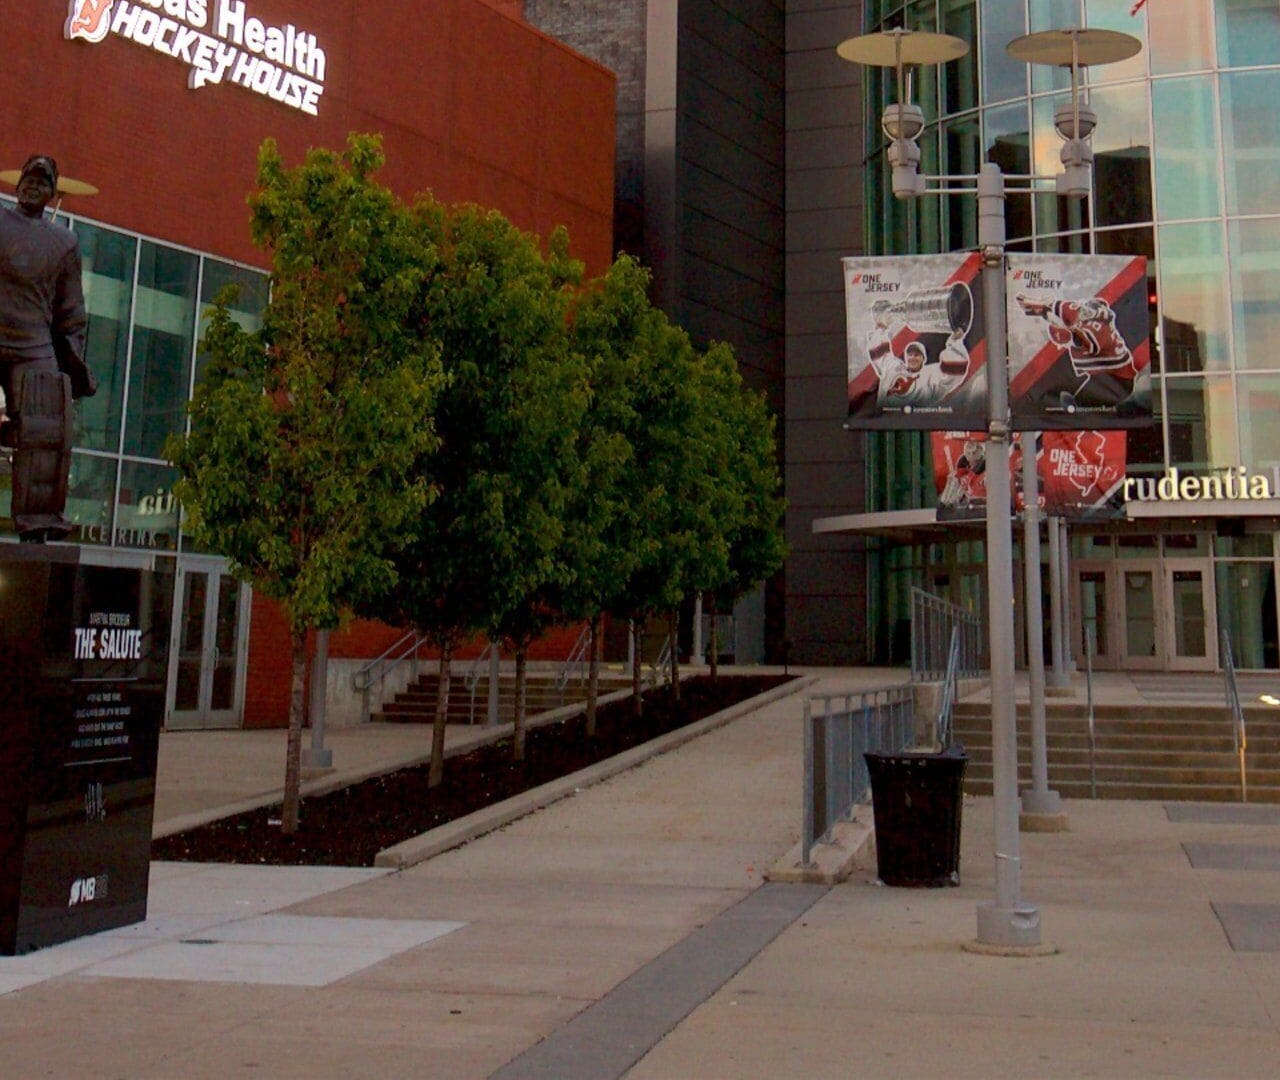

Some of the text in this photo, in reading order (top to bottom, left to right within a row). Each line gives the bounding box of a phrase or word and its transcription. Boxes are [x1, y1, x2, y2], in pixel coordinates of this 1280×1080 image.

[111, 0, 324, 116] HOCKEY HOUSE
[862, 273, 882, 283] ONE
[1024, 270, 1043, 280] ONE
[864, 282, 900, 293] JERSEY
[1026, 279, 1062, 289] JERSEY
[1050, 448, 1076, 463] ONE
[1053, 464, 1102, 477] JERSEY
[81, 524, 157, 547] ICE RINK
[74, 628, 143, 660] THE SALUTE
